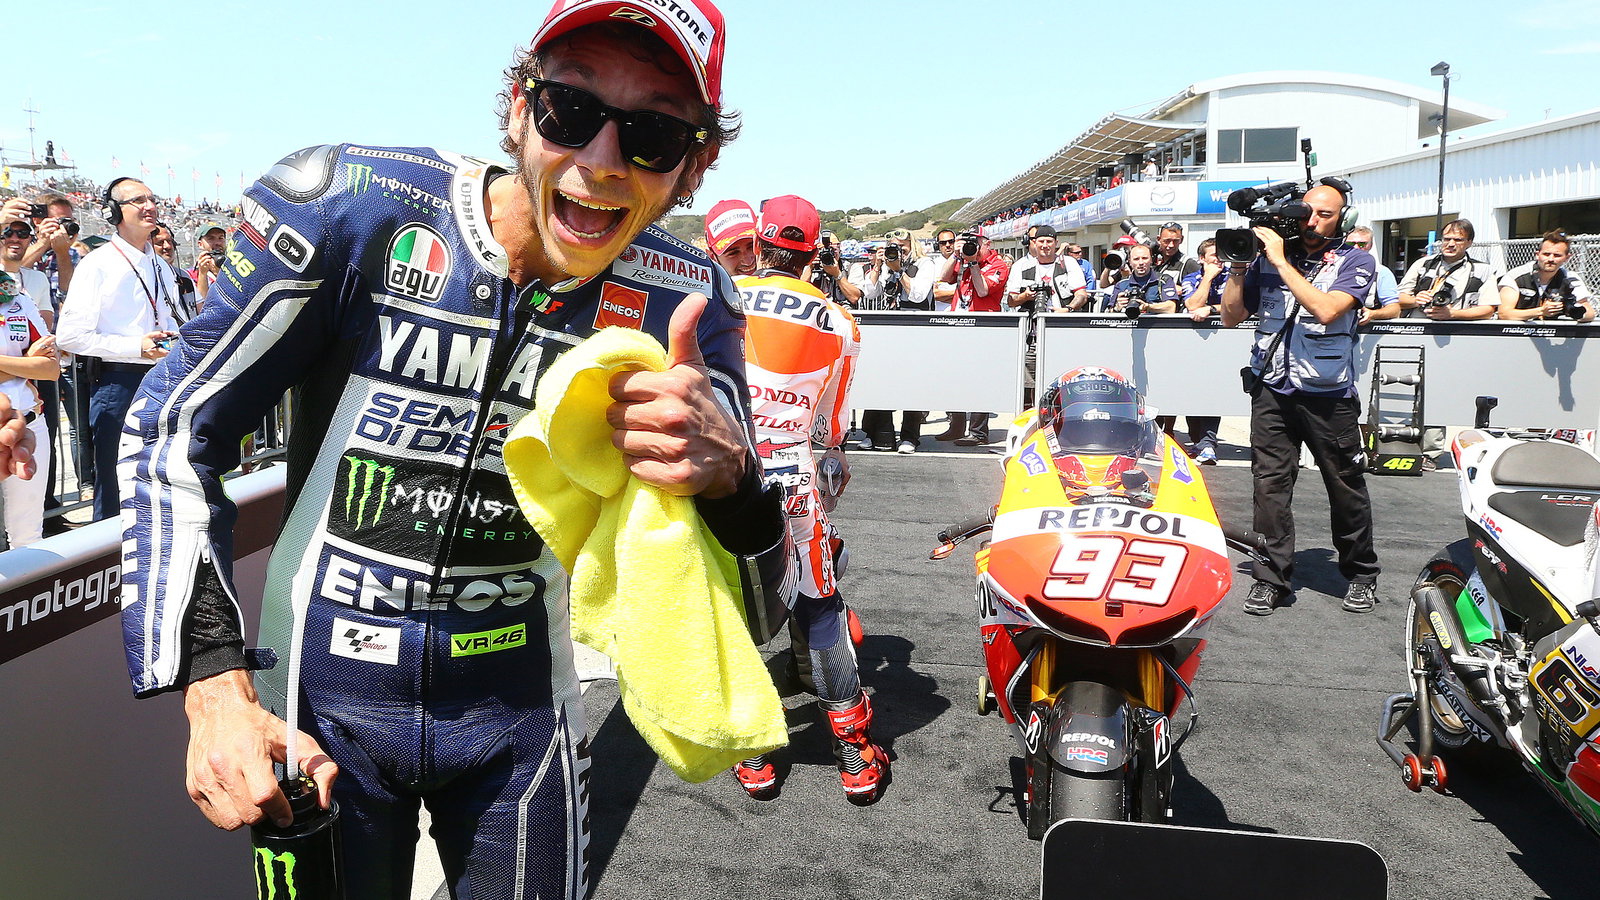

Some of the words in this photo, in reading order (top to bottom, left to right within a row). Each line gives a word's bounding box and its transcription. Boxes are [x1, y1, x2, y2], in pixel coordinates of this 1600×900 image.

[371, 174, 452, 214] MONSTER
[383, 192, 438, 217] ENERGY
[640, 249, 710, 284] YAMAHA
[631, 268, 661, 281] Revs
[661, 276, 682, 285] Your
[602, 300, 641, 319] ENEOS
[930, 316, 976, 325] motogp.com
[1090, 318, 1138, 327] motogp.com
[1373, 324, 1425, 333] motogp.com
[1502, 326, 1556, 336] motogp.com
[379, 315, 562, 400] YAMA
[1079, 382, 1110, 391] SHOEI
[1383, 457, 1416, 470] 46
[1093, 496, 1131, 504] HONDA
[414, 520, 533, 542] ENERGY
[1038, 506, 1187, 539] REPSOL
[1042, 536, 1189, 608] 93
[320, 553, 536, 613] ENEOS
[1430, 613, 1450, 647] ARROW
[1061, 732, 1116, 749] REPSOL
[1066, 747, 1109, 766] HRC
